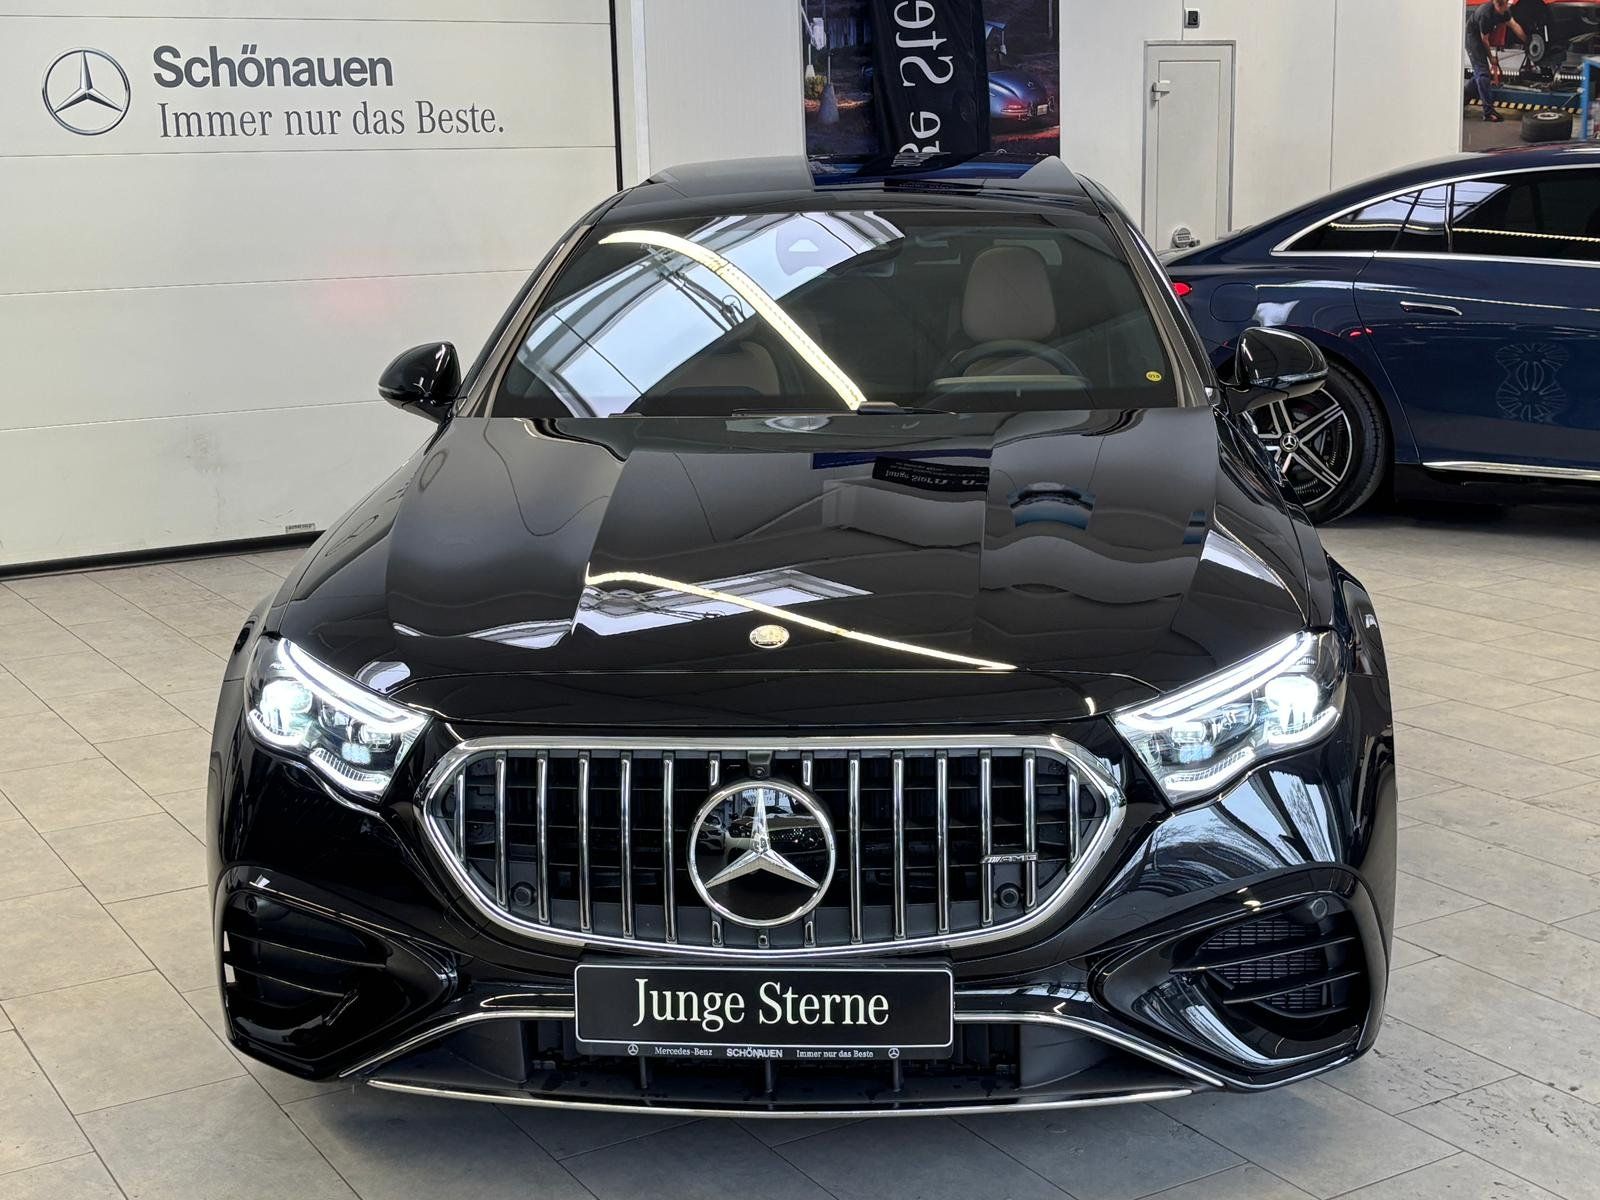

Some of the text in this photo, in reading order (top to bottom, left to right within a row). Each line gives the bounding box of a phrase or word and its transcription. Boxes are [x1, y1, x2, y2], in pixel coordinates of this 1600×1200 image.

[153, 44, 393, 88] Schönauen
[158, 100, 504, 138] Immer nur das Beste.
[632, 978, 889, 1032] Junge Sterne
[654, 1046, 713, 1056] Mercedes-Benz
[726, 1047, 783, 1058] SCHÖNAUEN
[796, 1050, 822, 1058] Immer
[838, 1050, 852, 1058] das
